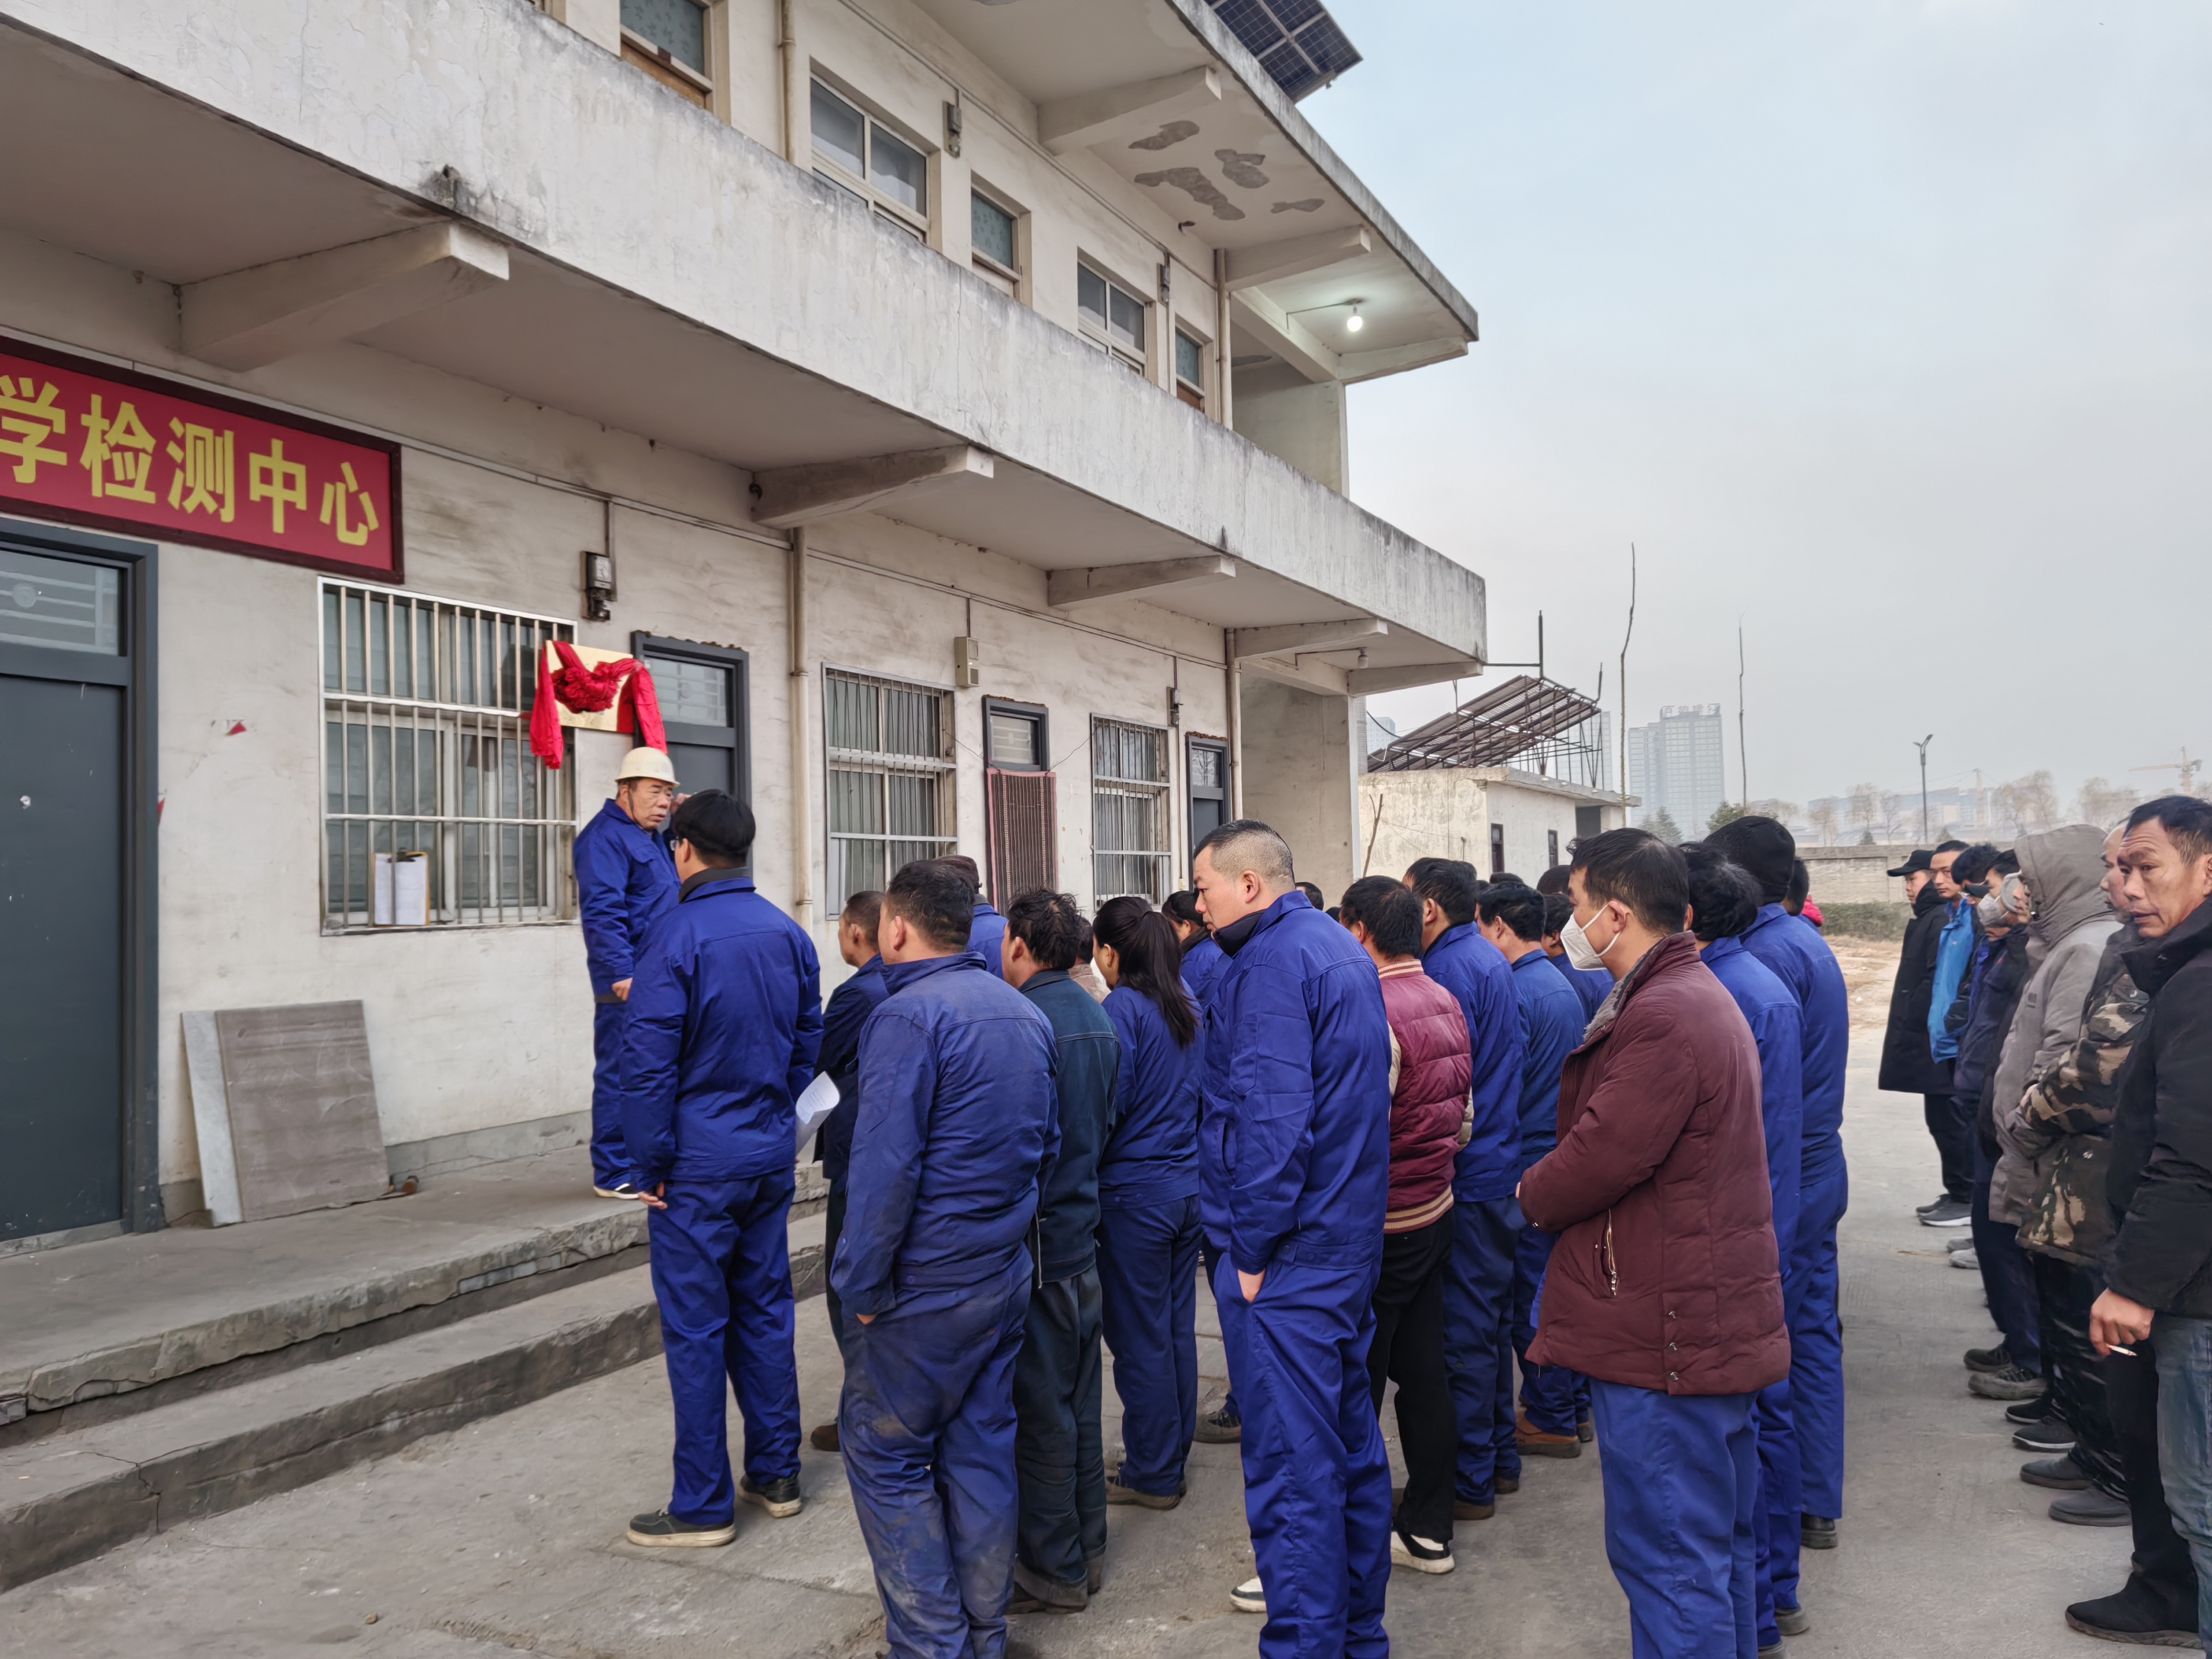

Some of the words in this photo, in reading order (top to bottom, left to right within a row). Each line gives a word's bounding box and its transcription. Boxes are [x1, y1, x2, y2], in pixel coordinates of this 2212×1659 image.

[0, 375, 379, 546] 学检测中心
